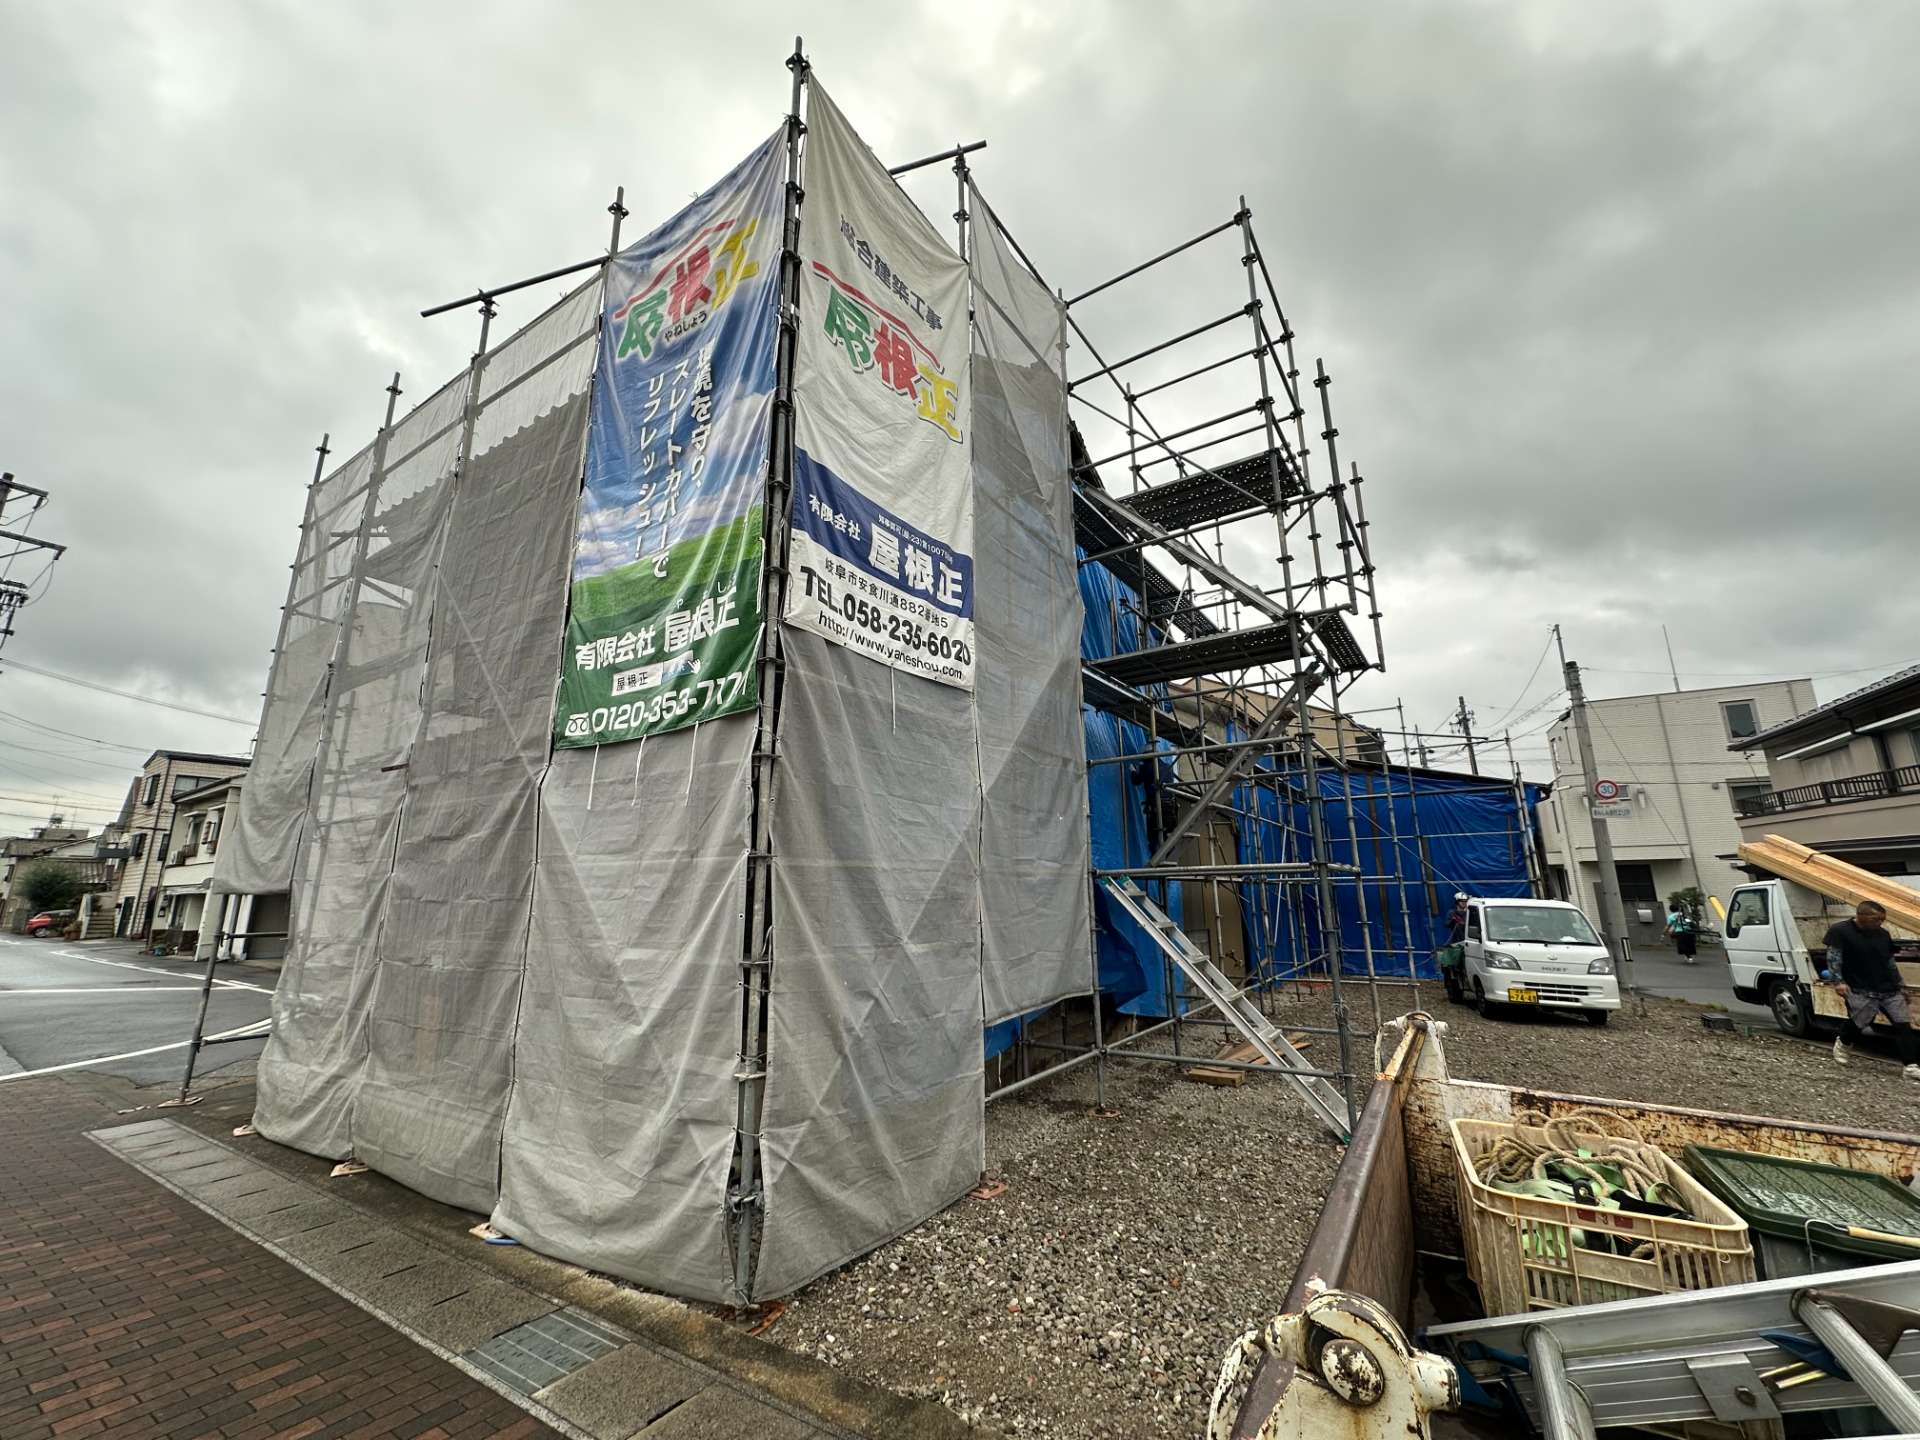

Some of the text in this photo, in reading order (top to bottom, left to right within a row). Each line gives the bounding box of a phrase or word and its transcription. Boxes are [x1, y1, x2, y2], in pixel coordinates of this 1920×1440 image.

[614, 216, 760, 359] 屋根正
[664, 311, 708, 342] やねしょう
[812, 262, 963, 444] 屋根正
[652, 359, 689, 578] スレートカバーで
[808, 493, 861, 541] 有限会社
[868, 522, 963, 609] 屋根正
[575, 625, 656, 670] 有限会社
[664, 586, 740, 653] 屋根正
[819, 610, 962, 681] http://www.yaneshou.com
[1600, 784, 1613, 794] 30
